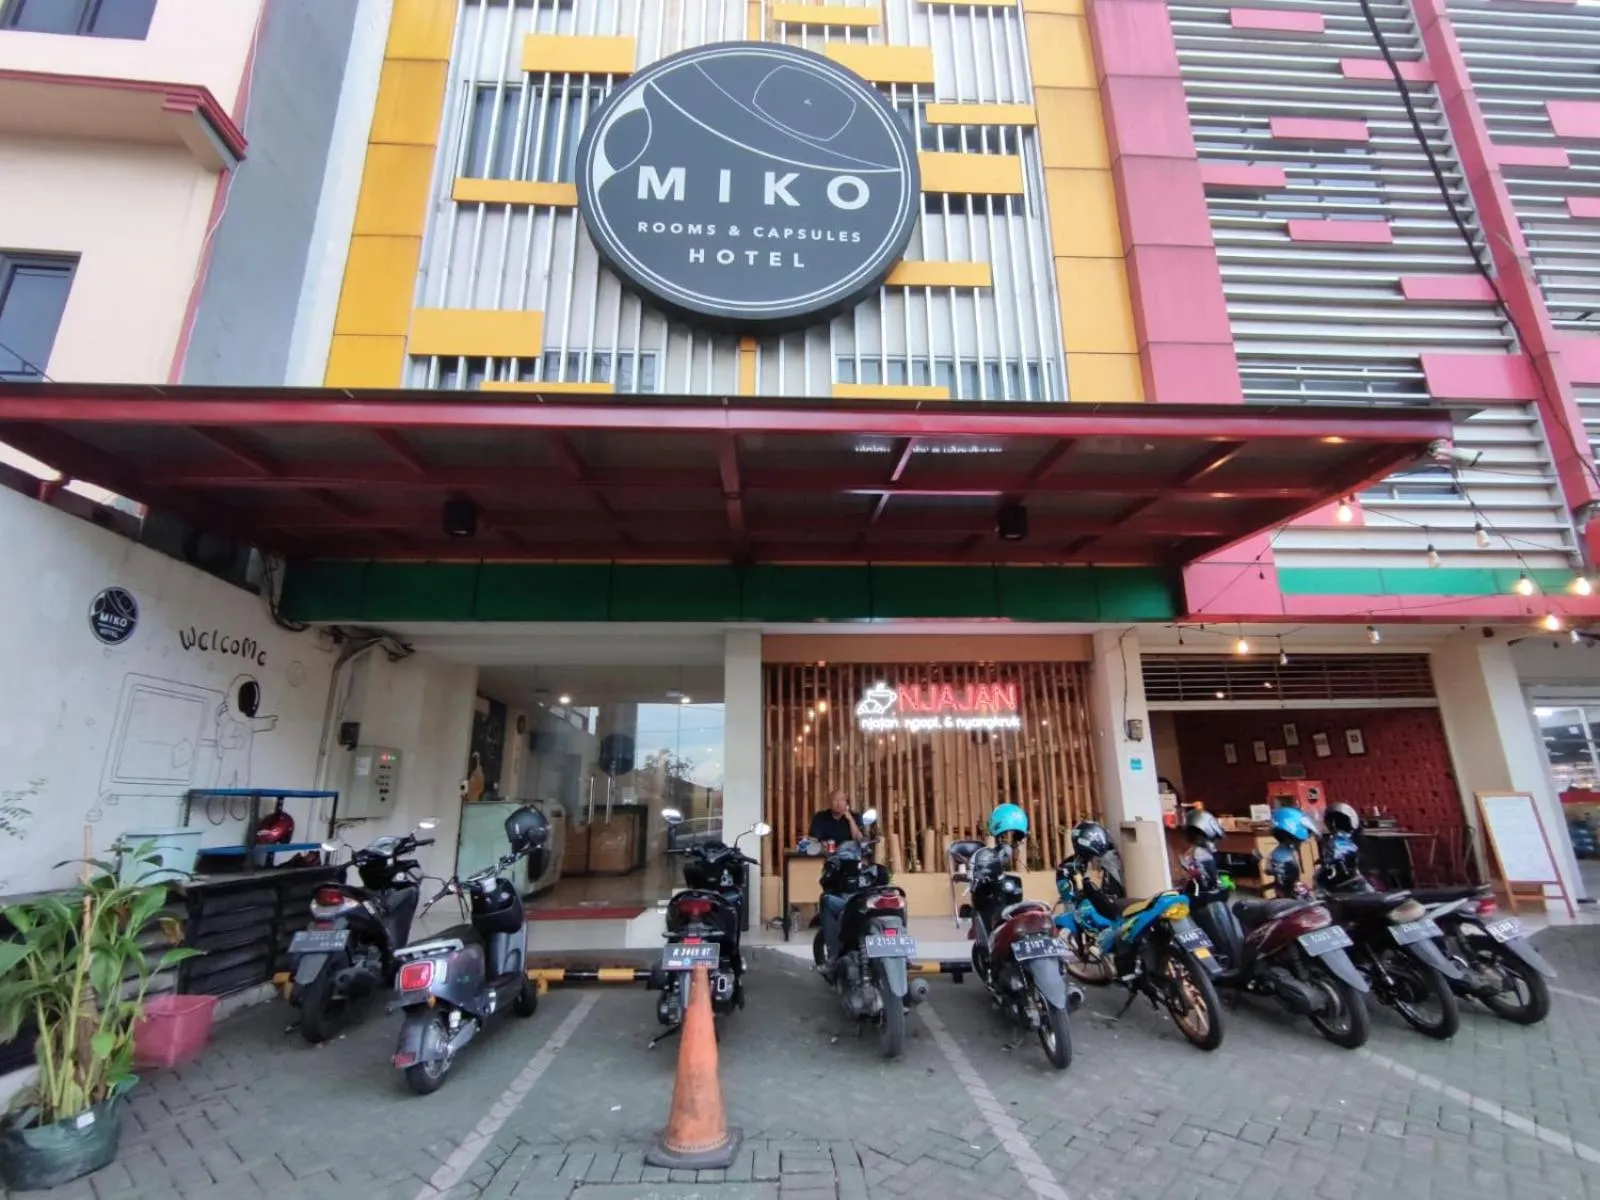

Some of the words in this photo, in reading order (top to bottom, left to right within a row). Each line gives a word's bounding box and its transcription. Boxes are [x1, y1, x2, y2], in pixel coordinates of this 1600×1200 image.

[638, 165, 870, 210] MIKO
[637, 221, 717, 236] ROOMS
[728, 224, 741, 237] &
[753, 226, 862, 243] CAPSULES
[689, 248, 805, 268] HOTEL
[100, 611, 128, 628] MIKO
[898, 683, 1018, 713] NJAJAN
[943, 715, 954, 730] &
